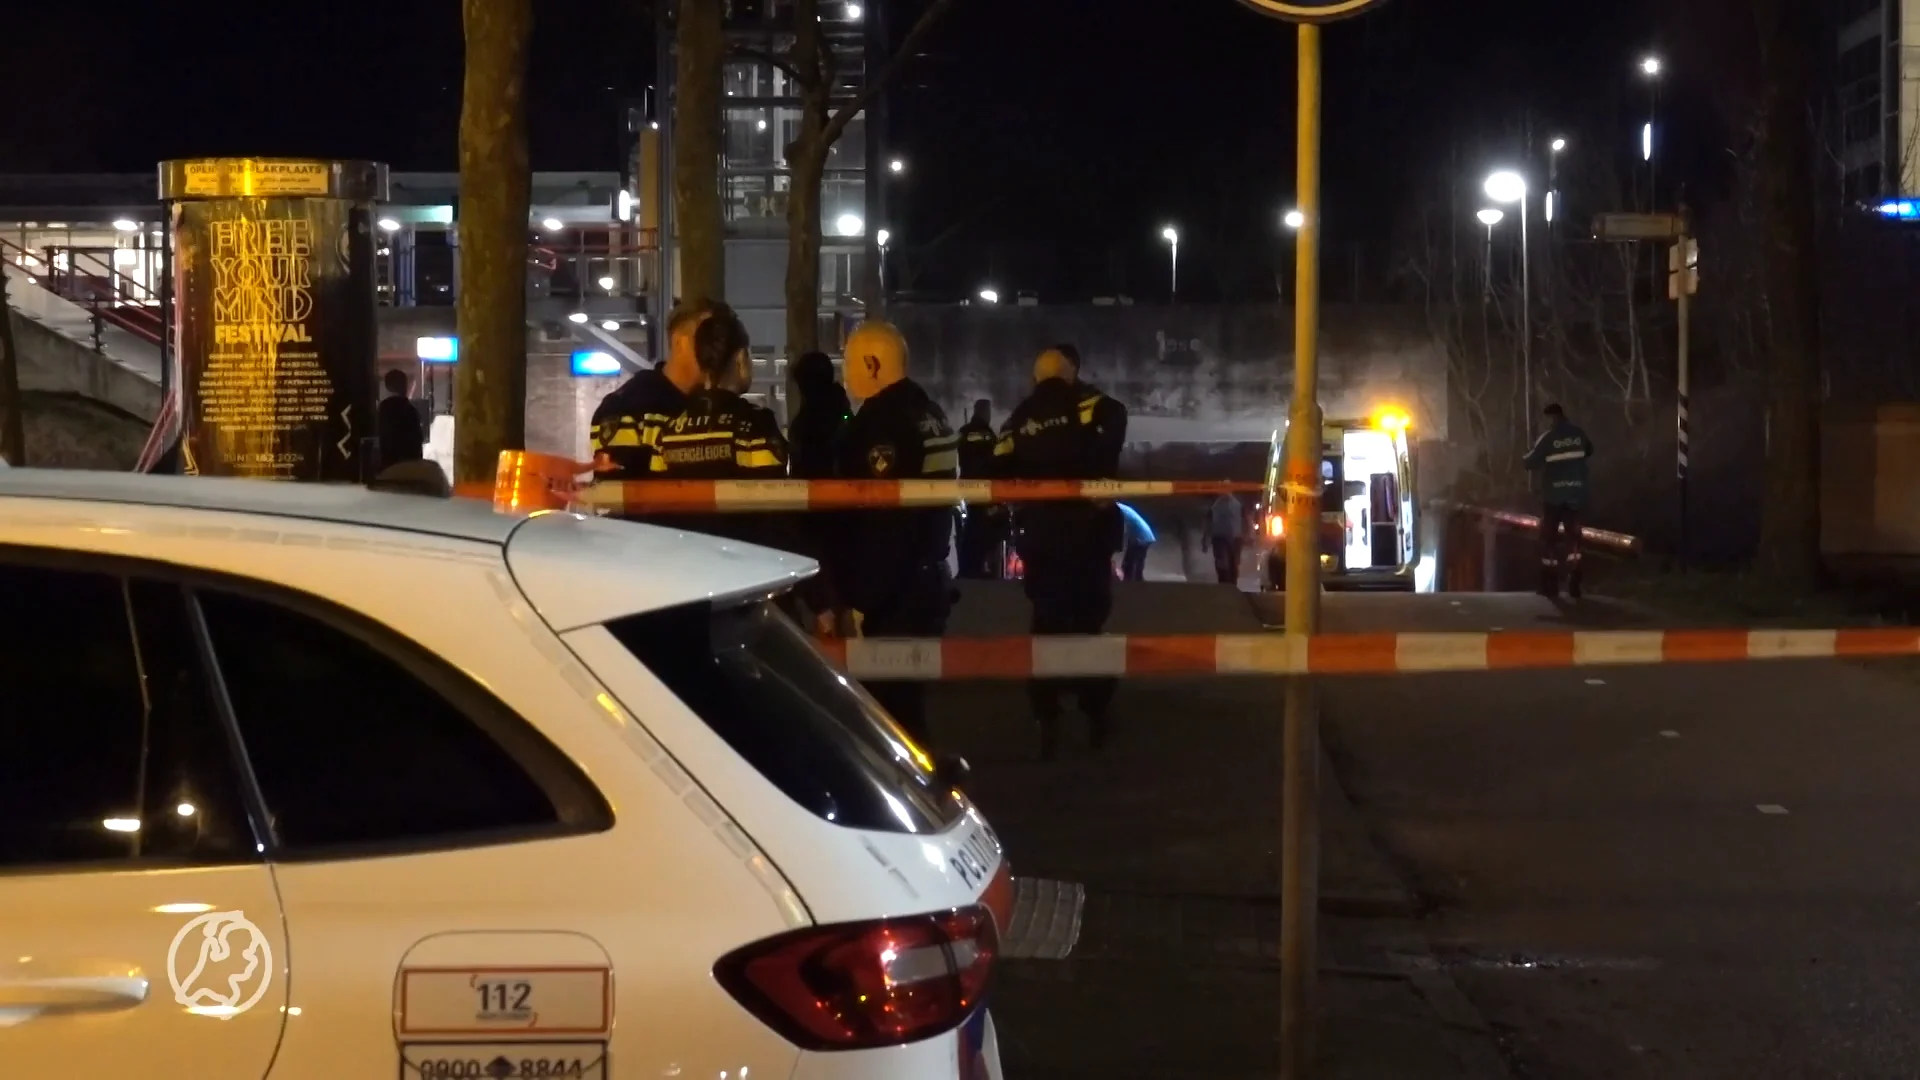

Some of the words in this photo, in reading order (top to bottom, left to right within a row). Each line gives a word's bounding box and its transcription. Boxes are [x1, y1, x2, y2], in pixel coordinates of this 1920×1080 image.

[210, 220, 311, 257] FREE
[211, 257, 312, 288] YOUR
[214, 287, 313, 322] MIND
[215, 323, 312, 344] FESTIVAL
